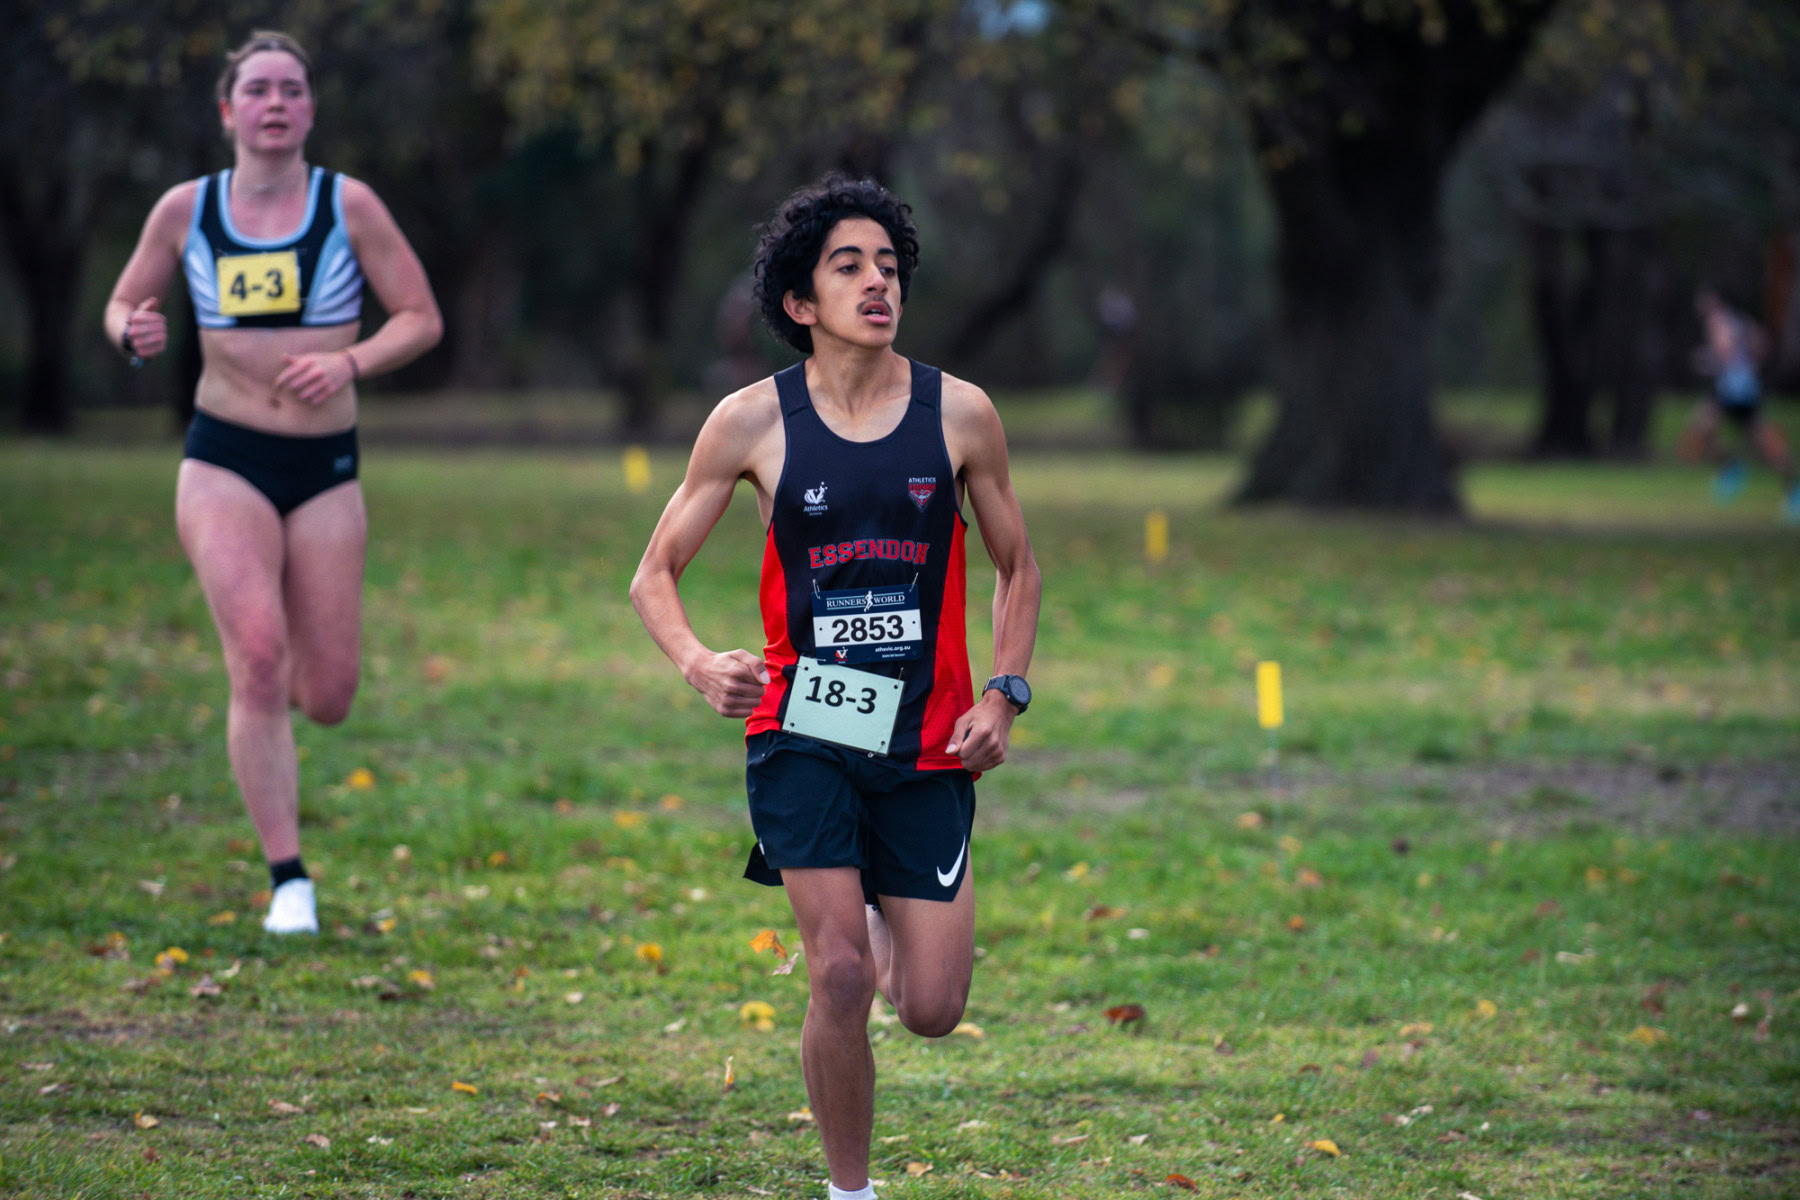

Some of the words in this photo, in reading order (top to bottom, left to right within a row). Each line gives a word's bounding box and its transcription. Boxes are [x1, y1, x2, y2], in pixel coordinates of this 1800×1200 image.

[230, 269, 285, 301] 4-3
[808, 539, 930, 569] ESSENDON
[826, 599, 866, 608] RUNNERS
[873, 594, 905, 604] WORLD
[832, 615, 904, 643] 2853
[805, 676, 877, 714] 18-3
